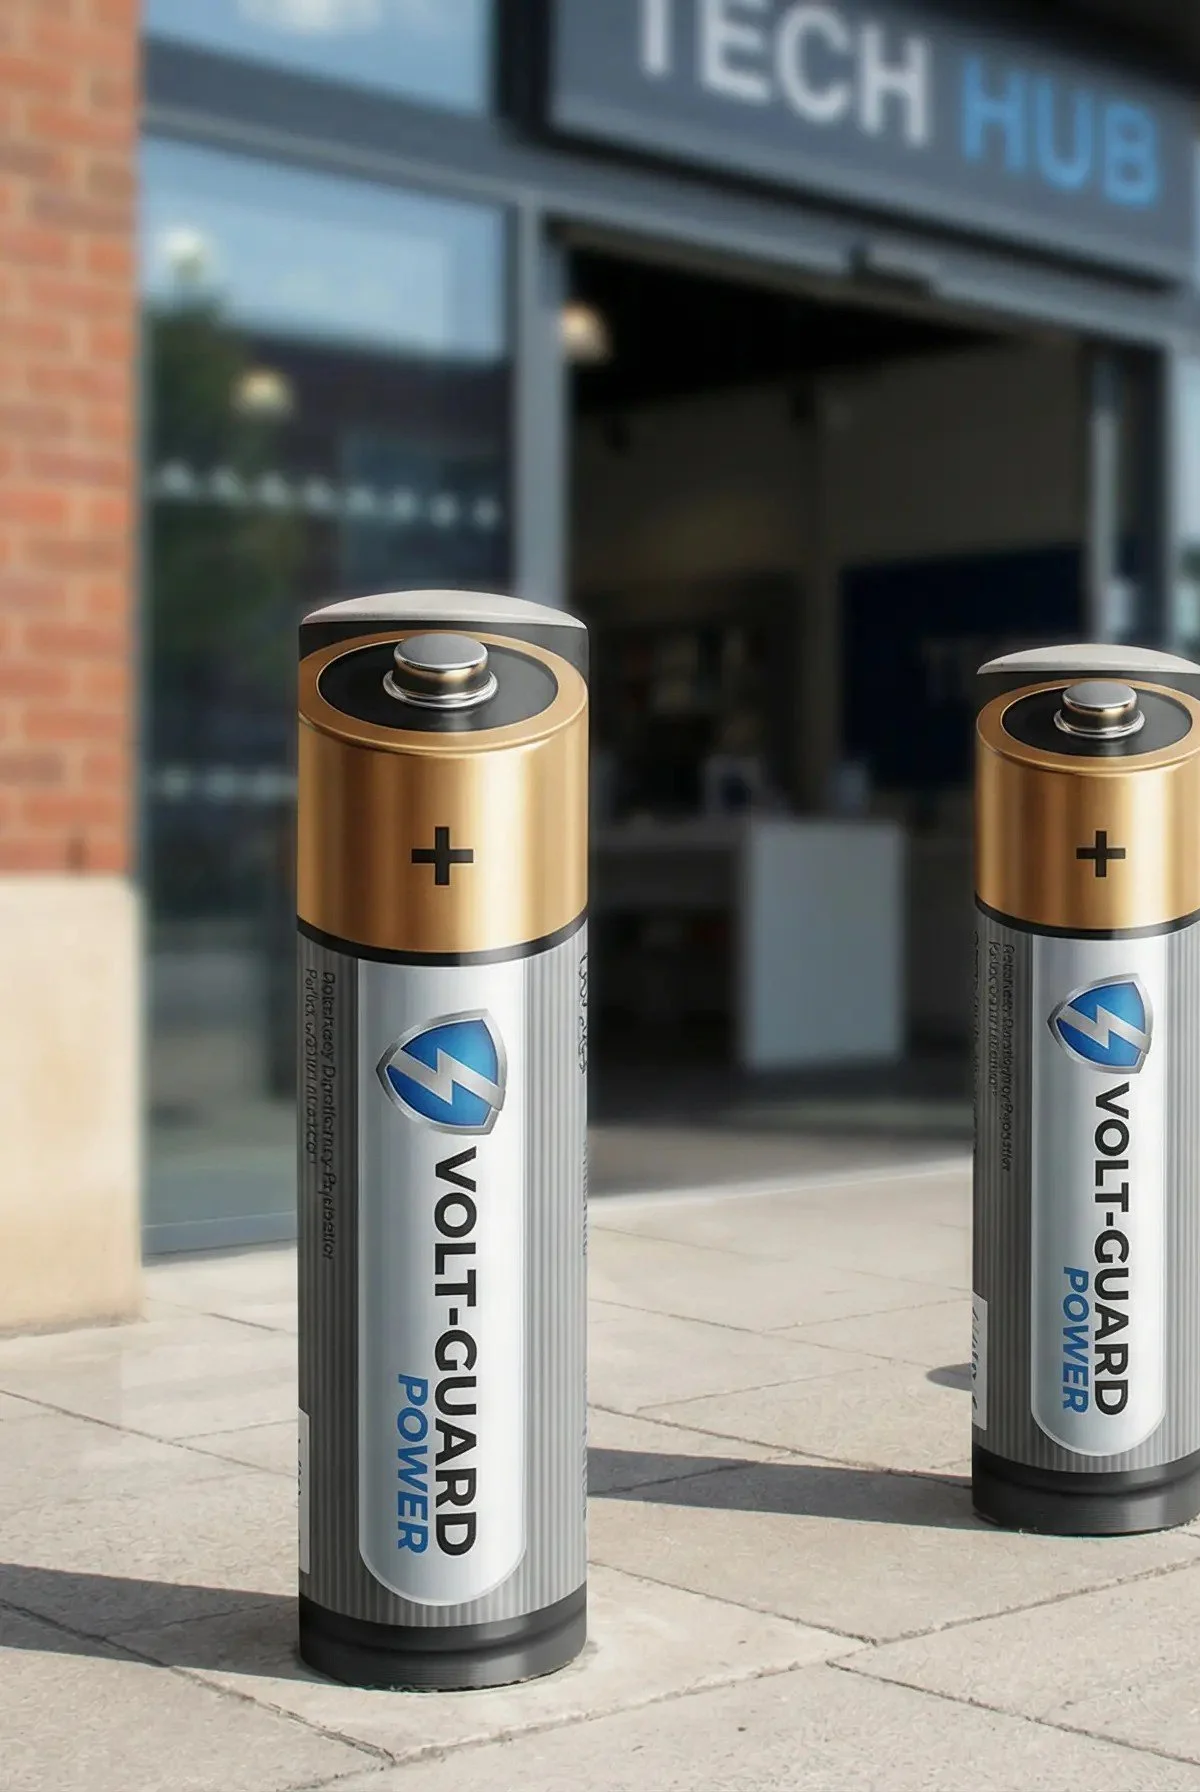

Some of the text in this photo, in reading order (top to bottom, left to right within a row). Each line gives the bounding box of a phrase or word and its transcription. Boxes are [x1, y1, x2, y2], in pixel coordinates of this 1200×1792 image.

[961, 56, 1161, 206] HUB
[1094, 1081, 1130, 1416] VOLT-GUARD
[434, 1146, 478, 1556] VOLT-GUARD
[1062, 1266, 1089, 1414] POWER
[397, 1373, 429, 1554] POWER
